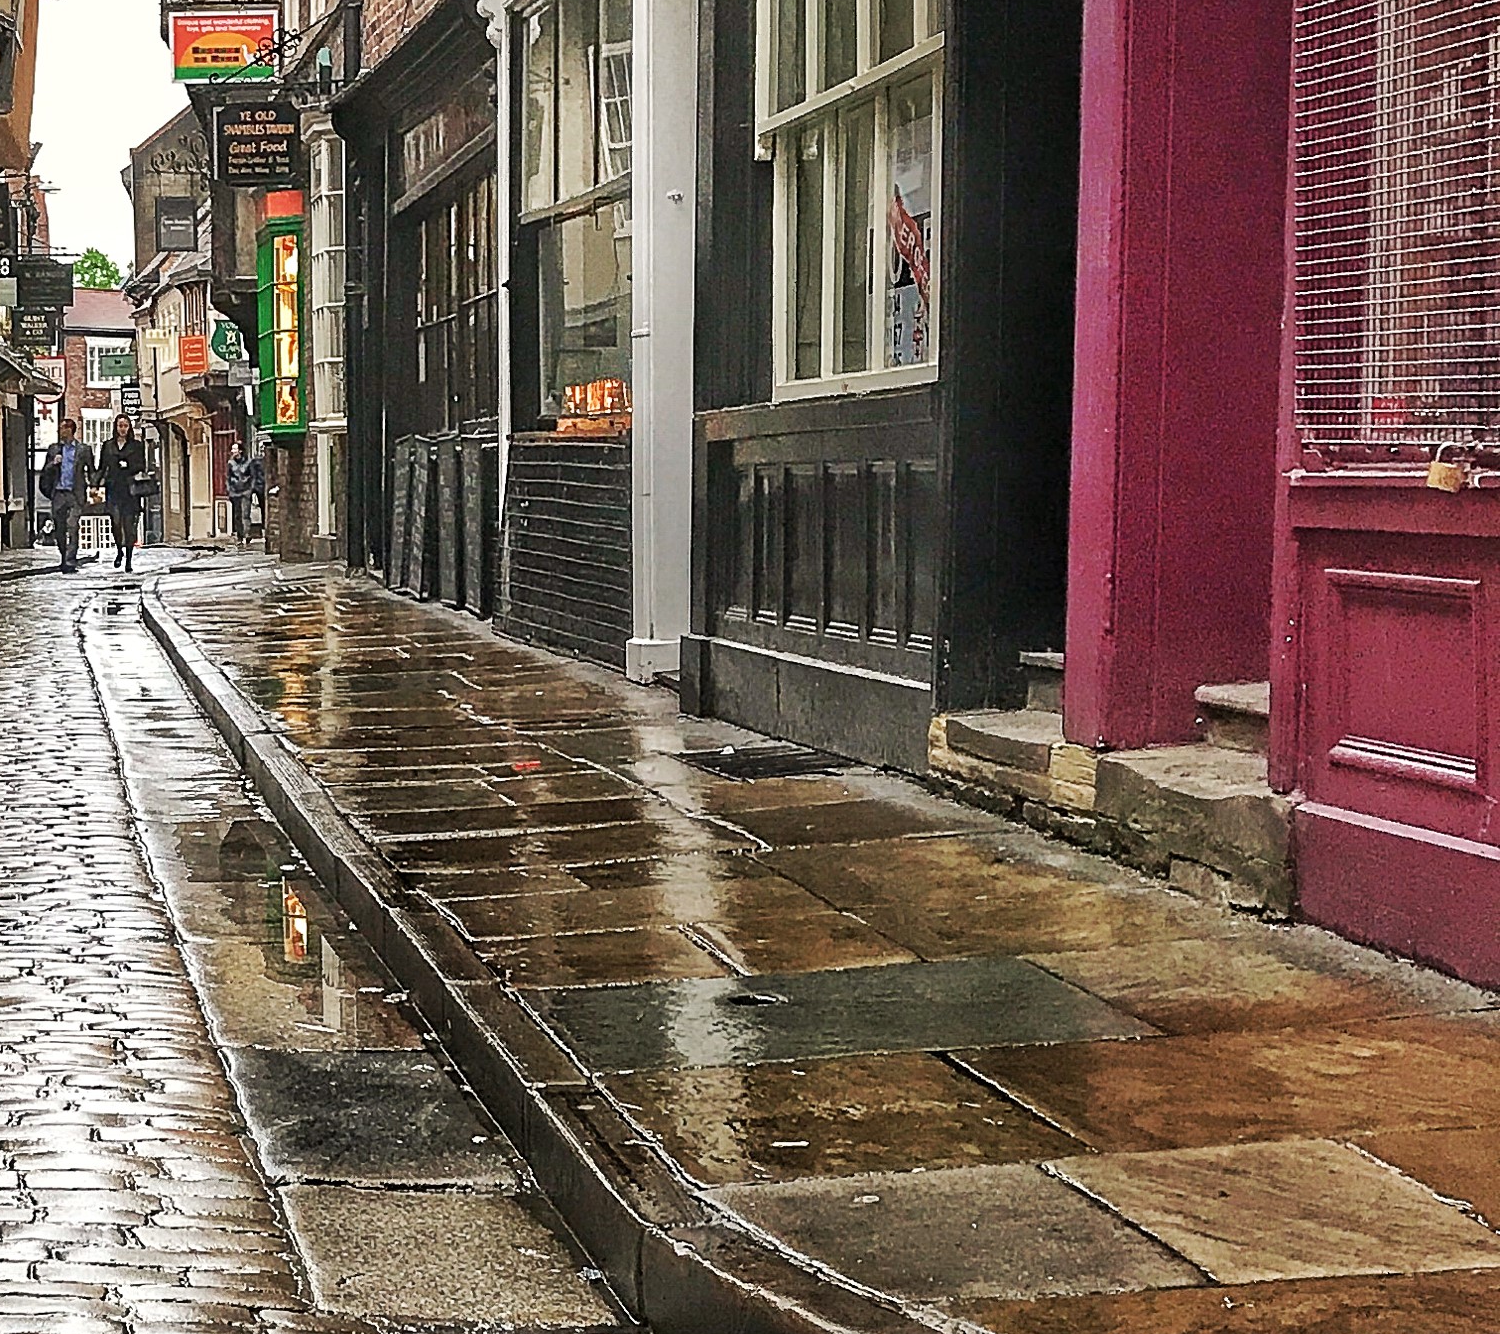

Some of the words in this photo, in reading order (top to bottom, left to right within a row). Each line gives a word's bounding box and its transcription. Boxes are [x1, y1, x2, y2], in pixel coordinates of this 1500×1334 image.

[239, 110, 252, 121] YE
[254, 110, 277, 121] OLD
[228, 141, 257, 154] Great
[260, 139, 288, 153] Food
